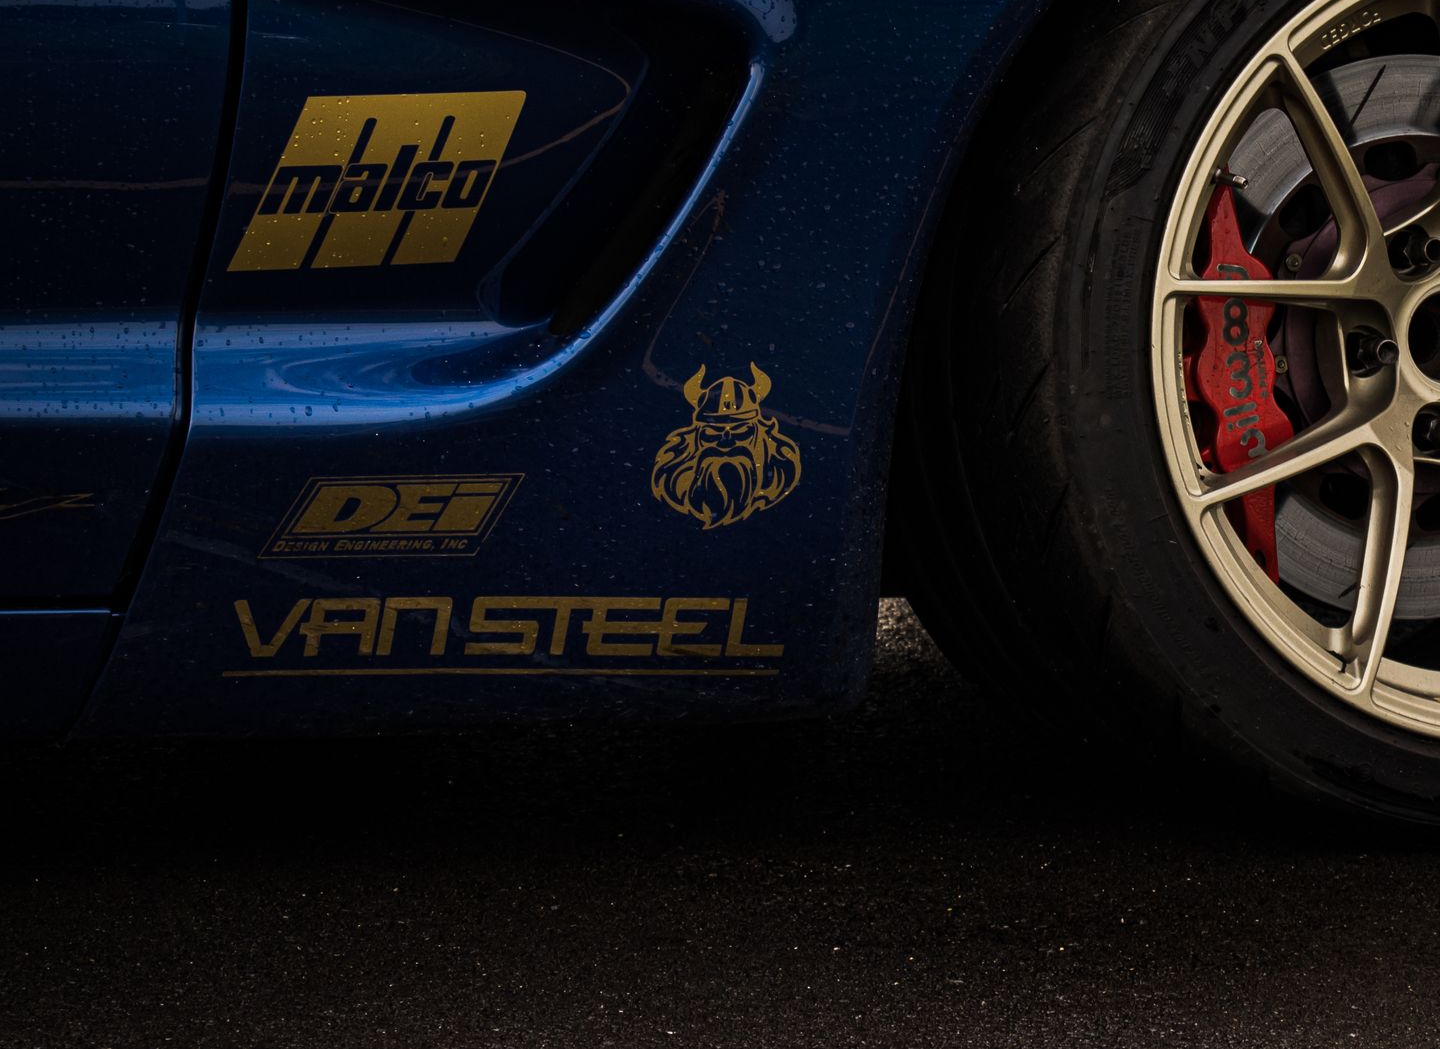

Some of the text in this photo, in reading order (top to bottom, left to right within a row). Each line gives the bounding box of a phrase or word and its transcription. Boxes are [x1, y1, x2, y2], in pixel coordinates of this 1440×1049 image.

[257, 144, 498, 215] malco
[271, 539, 328, 552] DESIGN
[234, 596, 785, 657] VAN STEEL
